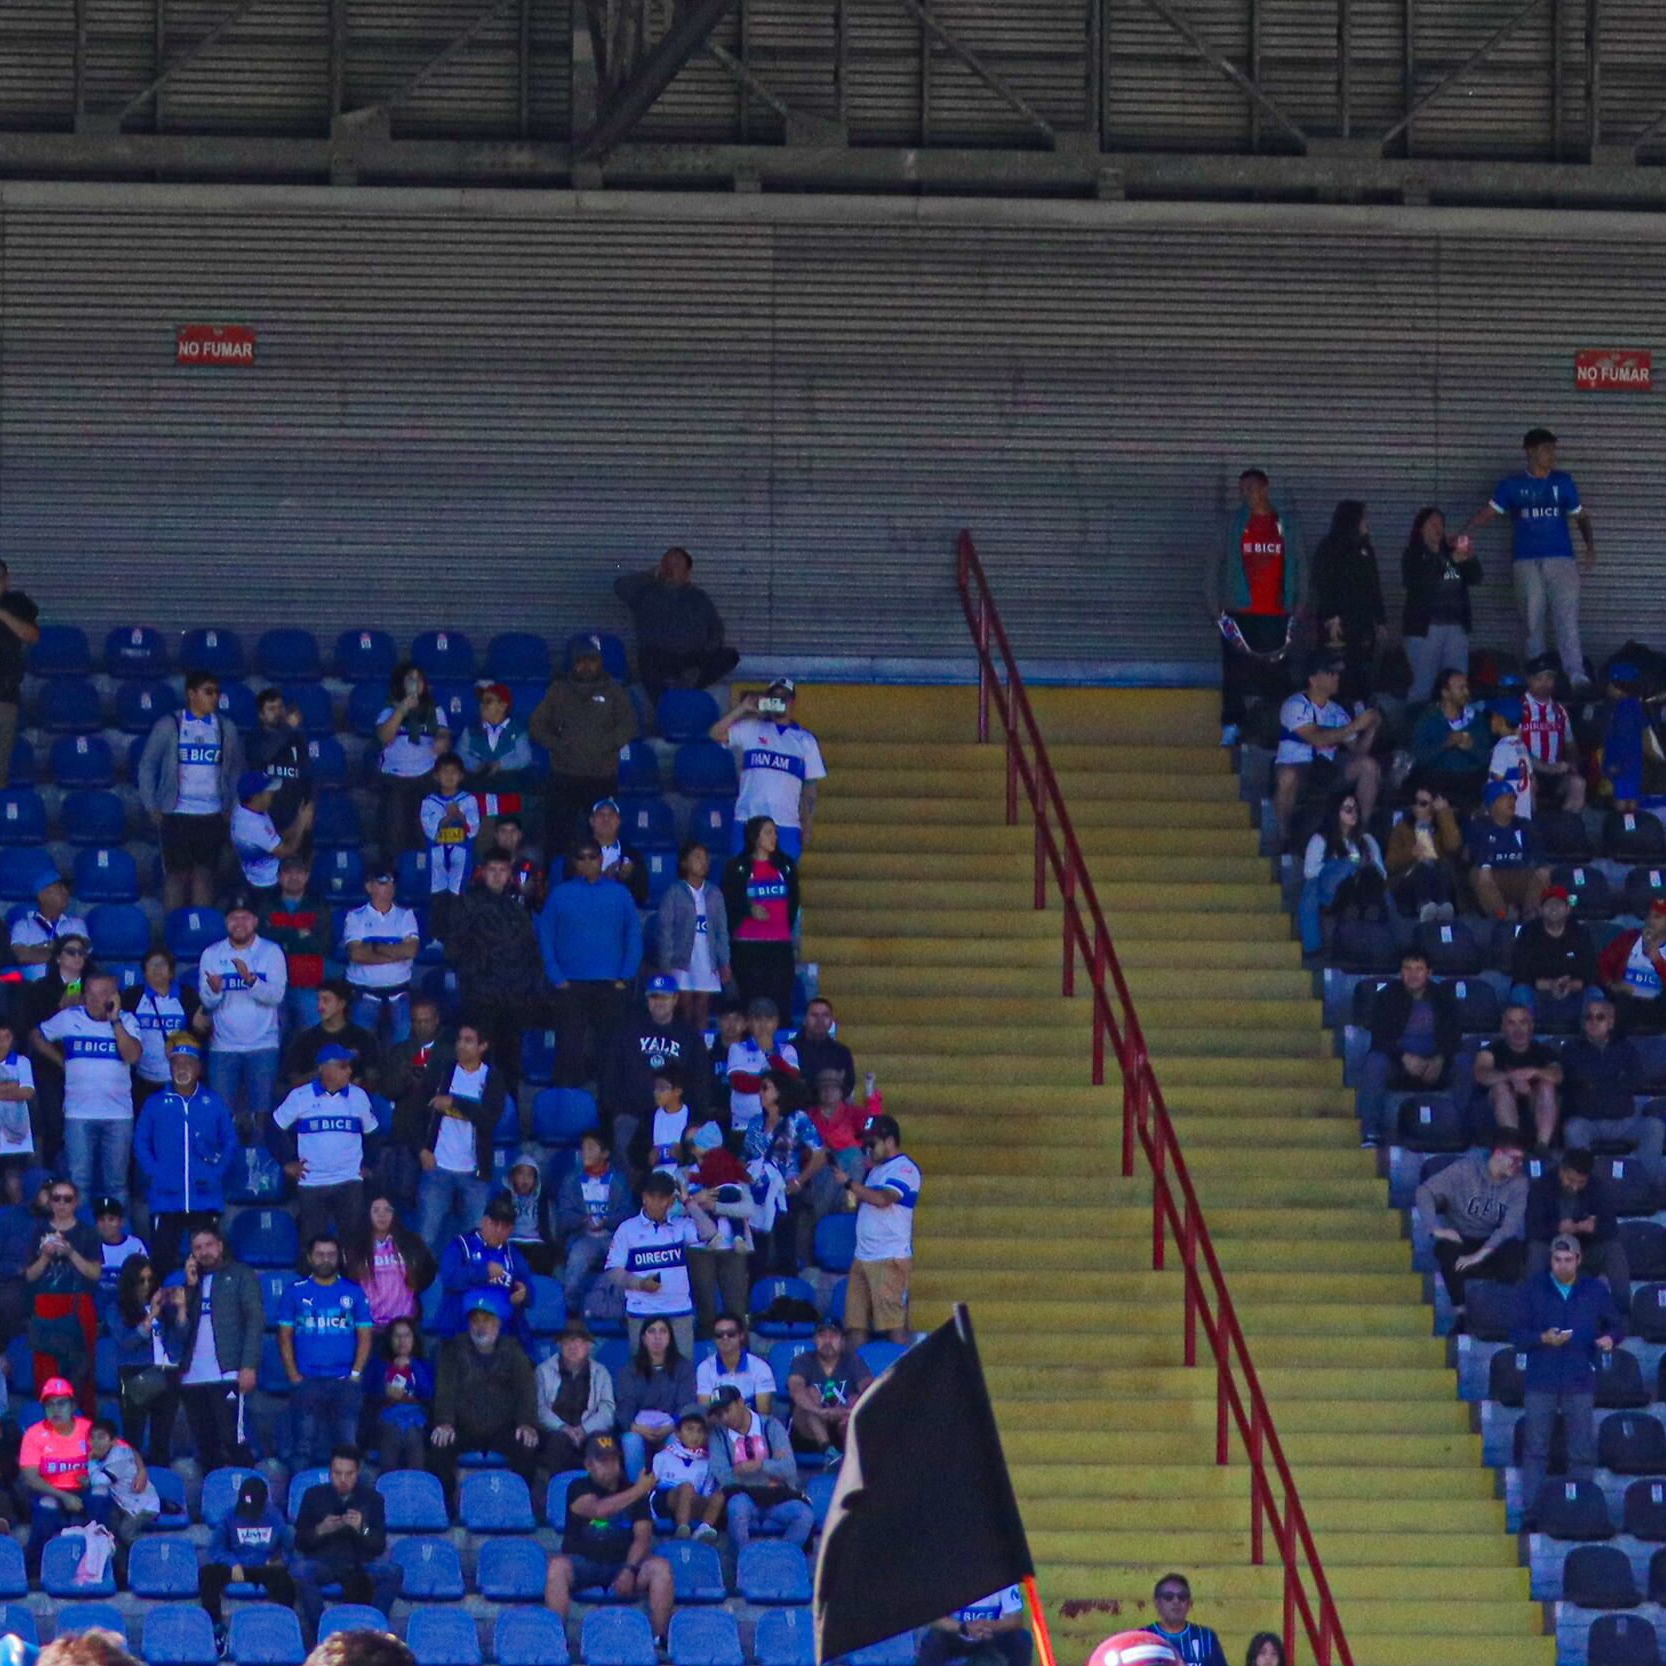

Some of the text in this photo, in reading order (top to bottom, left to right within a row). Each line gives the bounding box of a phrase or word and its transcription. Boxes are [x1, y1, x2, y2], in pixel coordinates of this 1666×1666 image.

[179, 342, 252, 357] NO FUMAR
[1577, 366, 1650, 381] NO FUMAR
[1531, 507, 1559, 518] BICE
[1254, 543, 1282, 554] BICE
[773, 755, 790, 770] AM
[1635, 972, 1655, 984] BIC
[84, 1041, 116, 1053] BICE
[639, 1036, 681, 1057] YALE
[321, 1119, 353, 1131] BICE
[634, 1248, 682, 1266] DIRECTV
[317, 1314, 347, 1329] BICE
